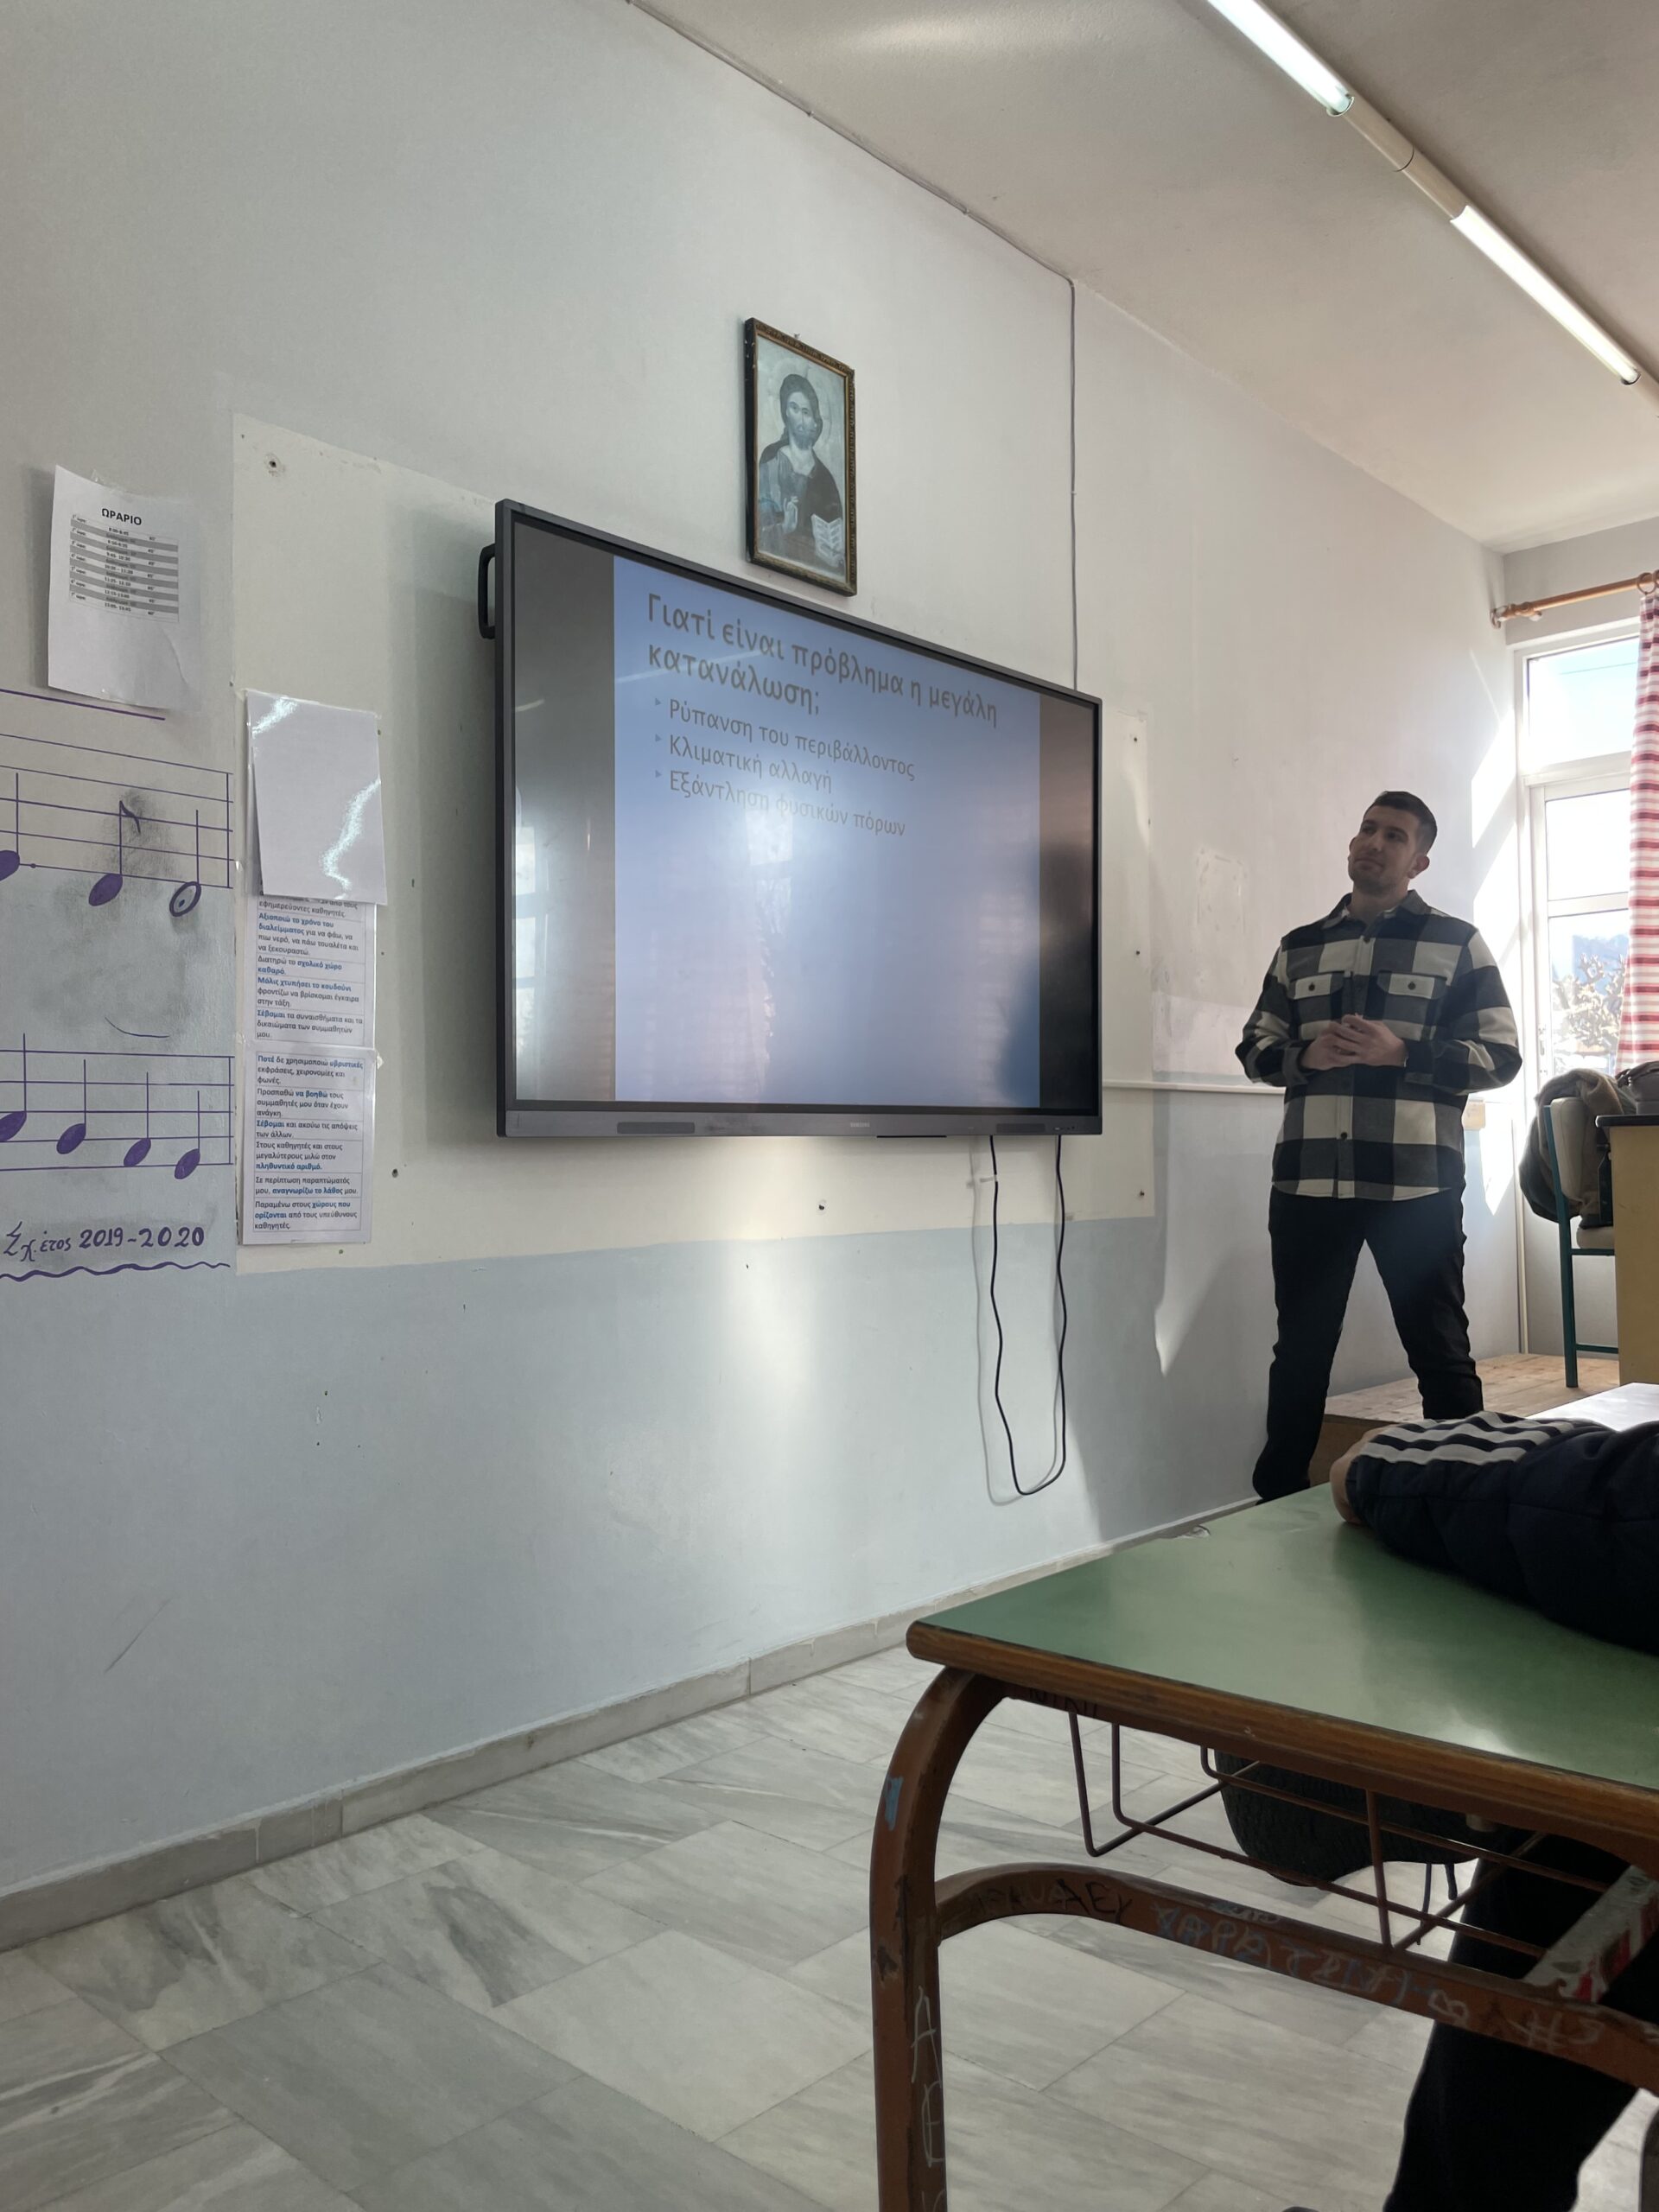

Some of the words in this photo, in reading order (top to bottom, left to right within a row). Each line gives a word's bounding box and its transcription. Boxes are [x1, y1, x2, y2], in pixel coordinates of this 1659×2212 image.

[101, 508, 142, 525] ΩΡΑΡΙΟ
[648, 592, 715, 640] Γιατί
[721, 617, 785, 660] είναι
[791, 643, 903, 696] πρόβλημα
[910, 678, 921, 706] η
[928, 686, 997, 728] μεγάλη
[648, 645, 820, 716] κατανάλωση;
[670, 697, 753, 742] Ρύπανση
[760, 724, 789, 747] του
[795, 732, 915, 781] περιβάλλοντος
[670, 734, 762, 779] Κλιματική
[769, 760, 832, 793] αλλαγή
[670, 770, 769, 811] Εξάντληση
[853, 810, 906, 836] πόρων
